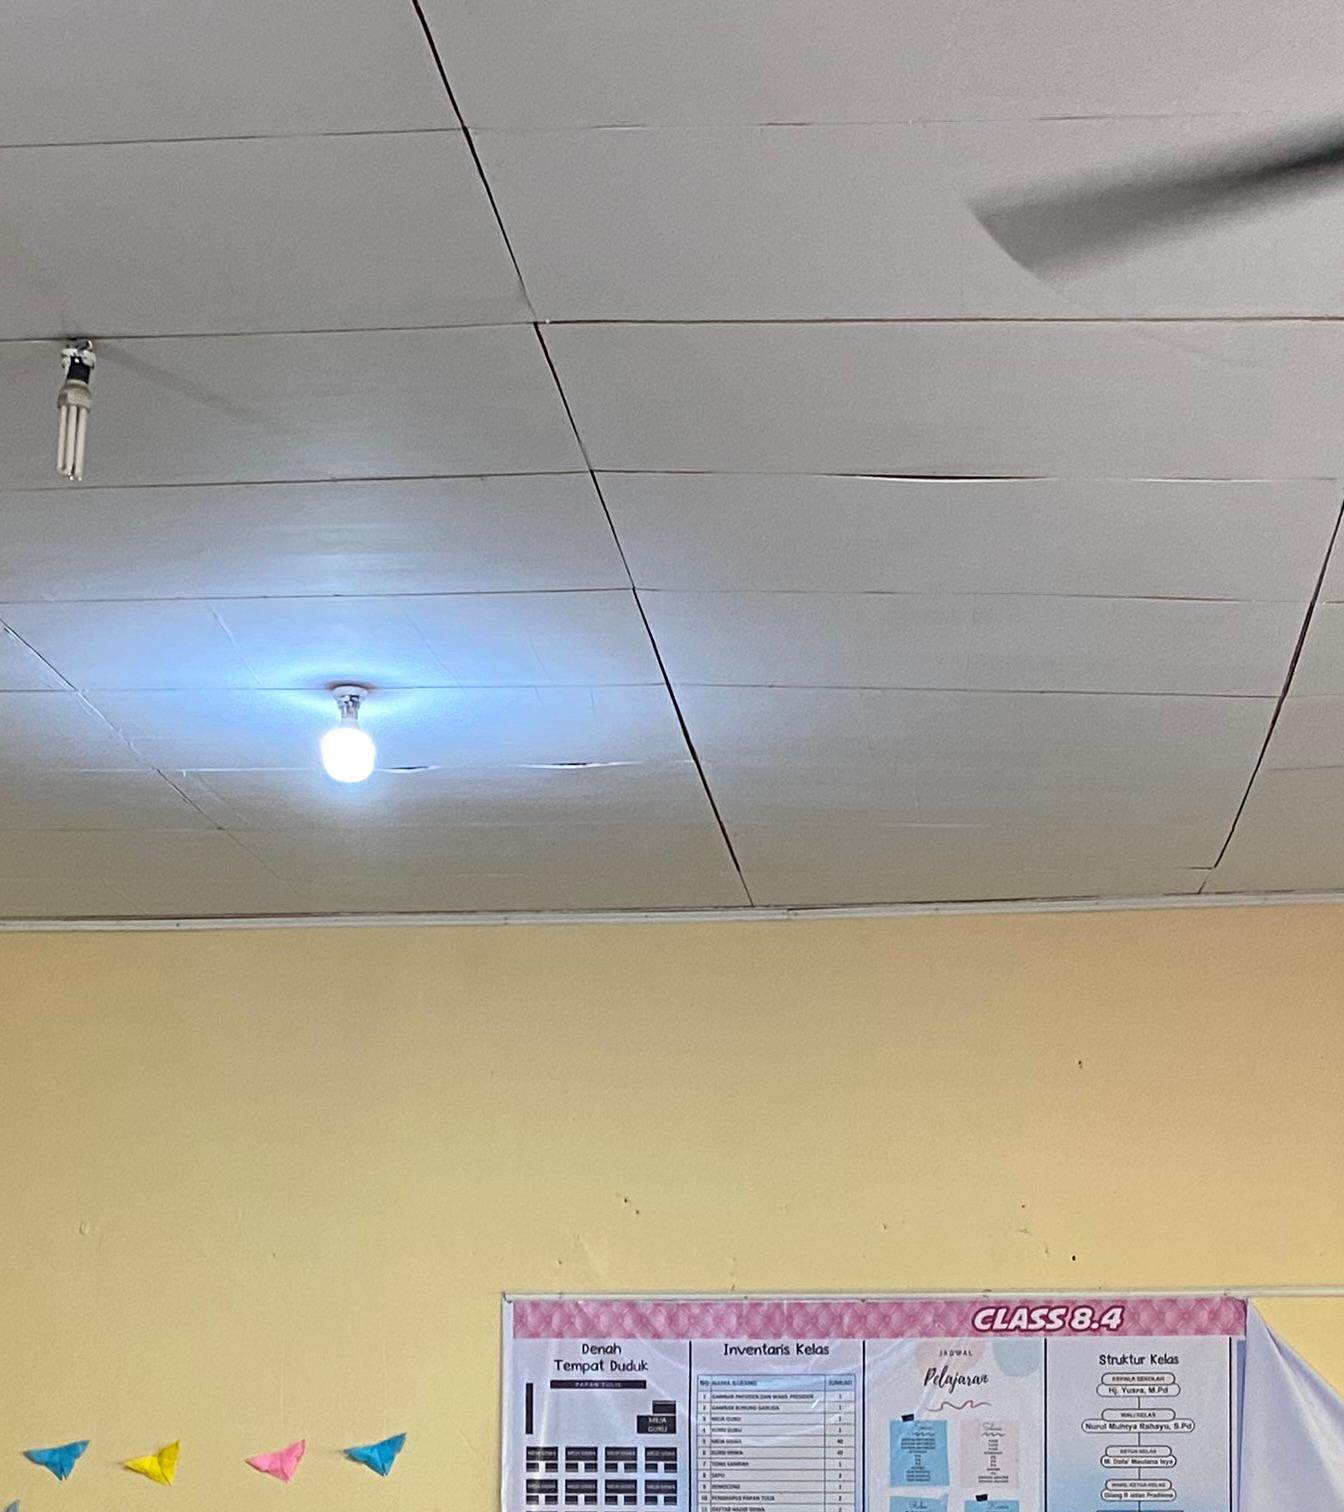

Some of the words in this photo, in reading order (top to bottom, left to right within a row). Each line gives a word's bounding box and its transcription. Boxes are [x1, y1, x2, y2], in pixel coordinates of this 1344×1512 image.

[973, 1306, 1069, 1332] CLASS
[1069, 1305, 1125, 1332] 8.4
[582, 1343, 621, 1354] Denah
[724, 1343, 790, 1356] Inventaris
[796, 1343, 829, 1355] Kelas
[939, 1349, 973, 1357] JADWAL
[1099, 1354, 1145, 1365] Struktur
[1150, 1354, 1179, 1365] Kelas
[554, 1359, 604, 1374] Tempat
[610, 1360, 648, 1371] Duduk
[924, 1365, 989, 1394] Pelajaran
